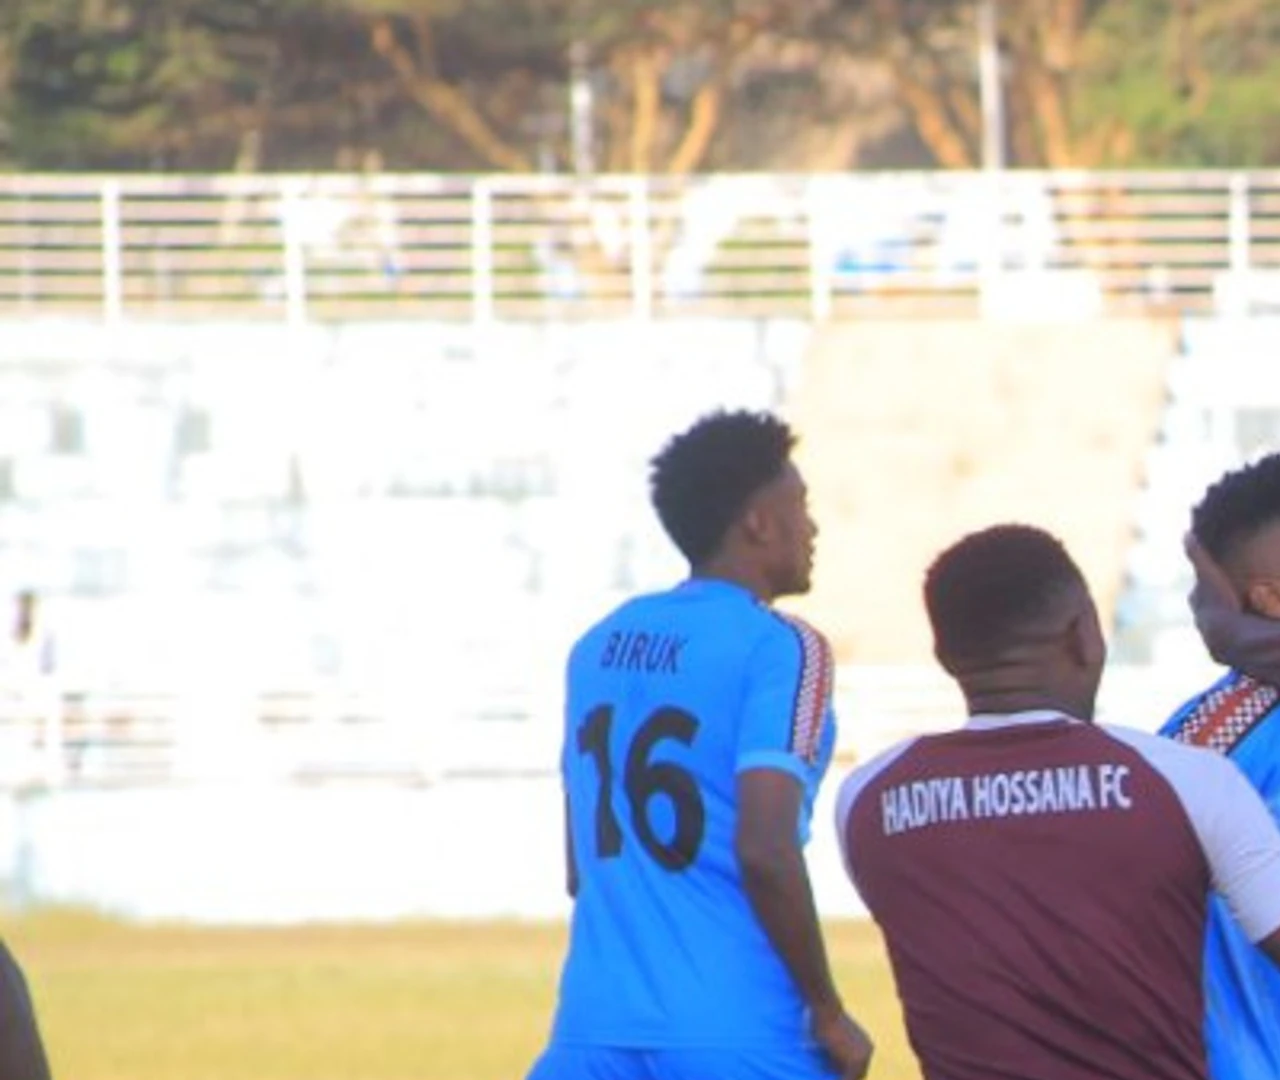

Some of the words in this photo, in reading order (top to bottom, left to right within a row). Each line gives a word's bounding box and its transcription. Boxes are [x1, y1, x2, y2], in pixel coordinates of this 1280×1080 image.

[600, 631, 688, 675] BIRUK
[576, 702, 704, 873] 16
[881, 775, 970, 836] HADIYA
[972, 764, 1097, 817] HOSSANA
[1098, 764, 1134, 809] FC
